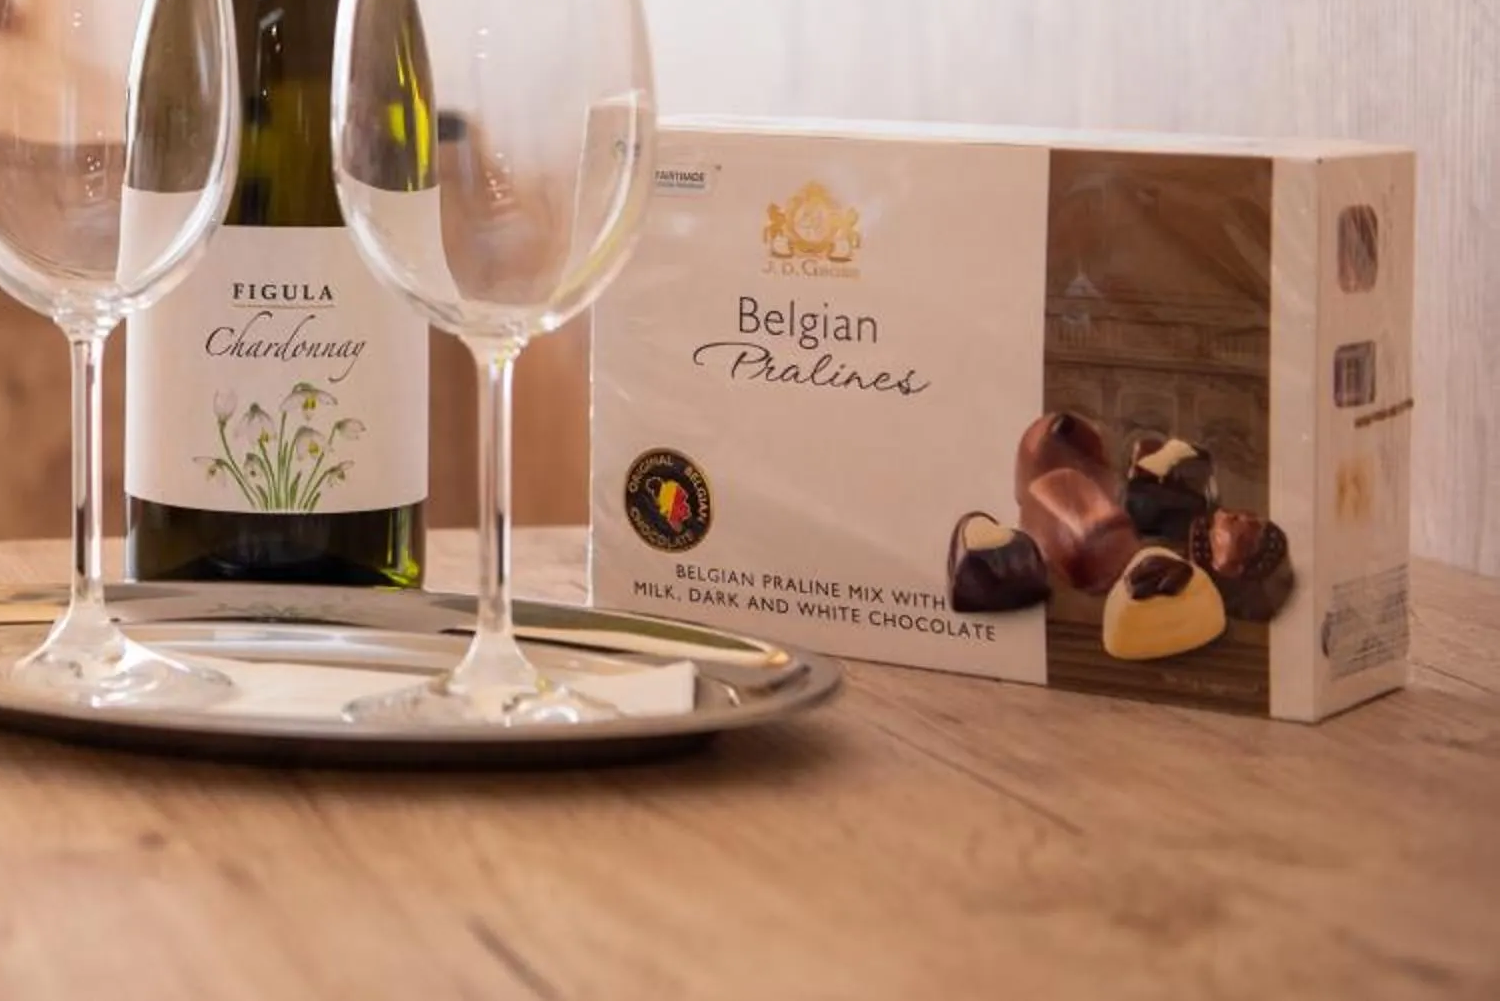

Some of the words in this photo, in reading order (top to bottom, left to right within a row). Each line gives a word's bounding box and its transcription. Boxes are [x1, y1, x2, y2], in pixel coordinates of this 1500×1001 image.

[232, 283, 334, 301] FIGULA
[205, 311, 367, 382] Chardonnay
[739, 297, 878, 350] Belgian
[693, 341, 931, 395] Pralines
[684, 466, 709, 524] BELGIAN
[676, 564, 754, 587] BELGIAN
[762, 573, 841, 598] PRALINE
[848, 584, 884, 604] MIX
[891, 589, 946, 611] WITH
[689, 588, 739, 608] DARK
[747, 597, 790, 614] AND
[797, 601, 861, 623] WHITE
[868, 610, 996, 642] CHOCOLATE
